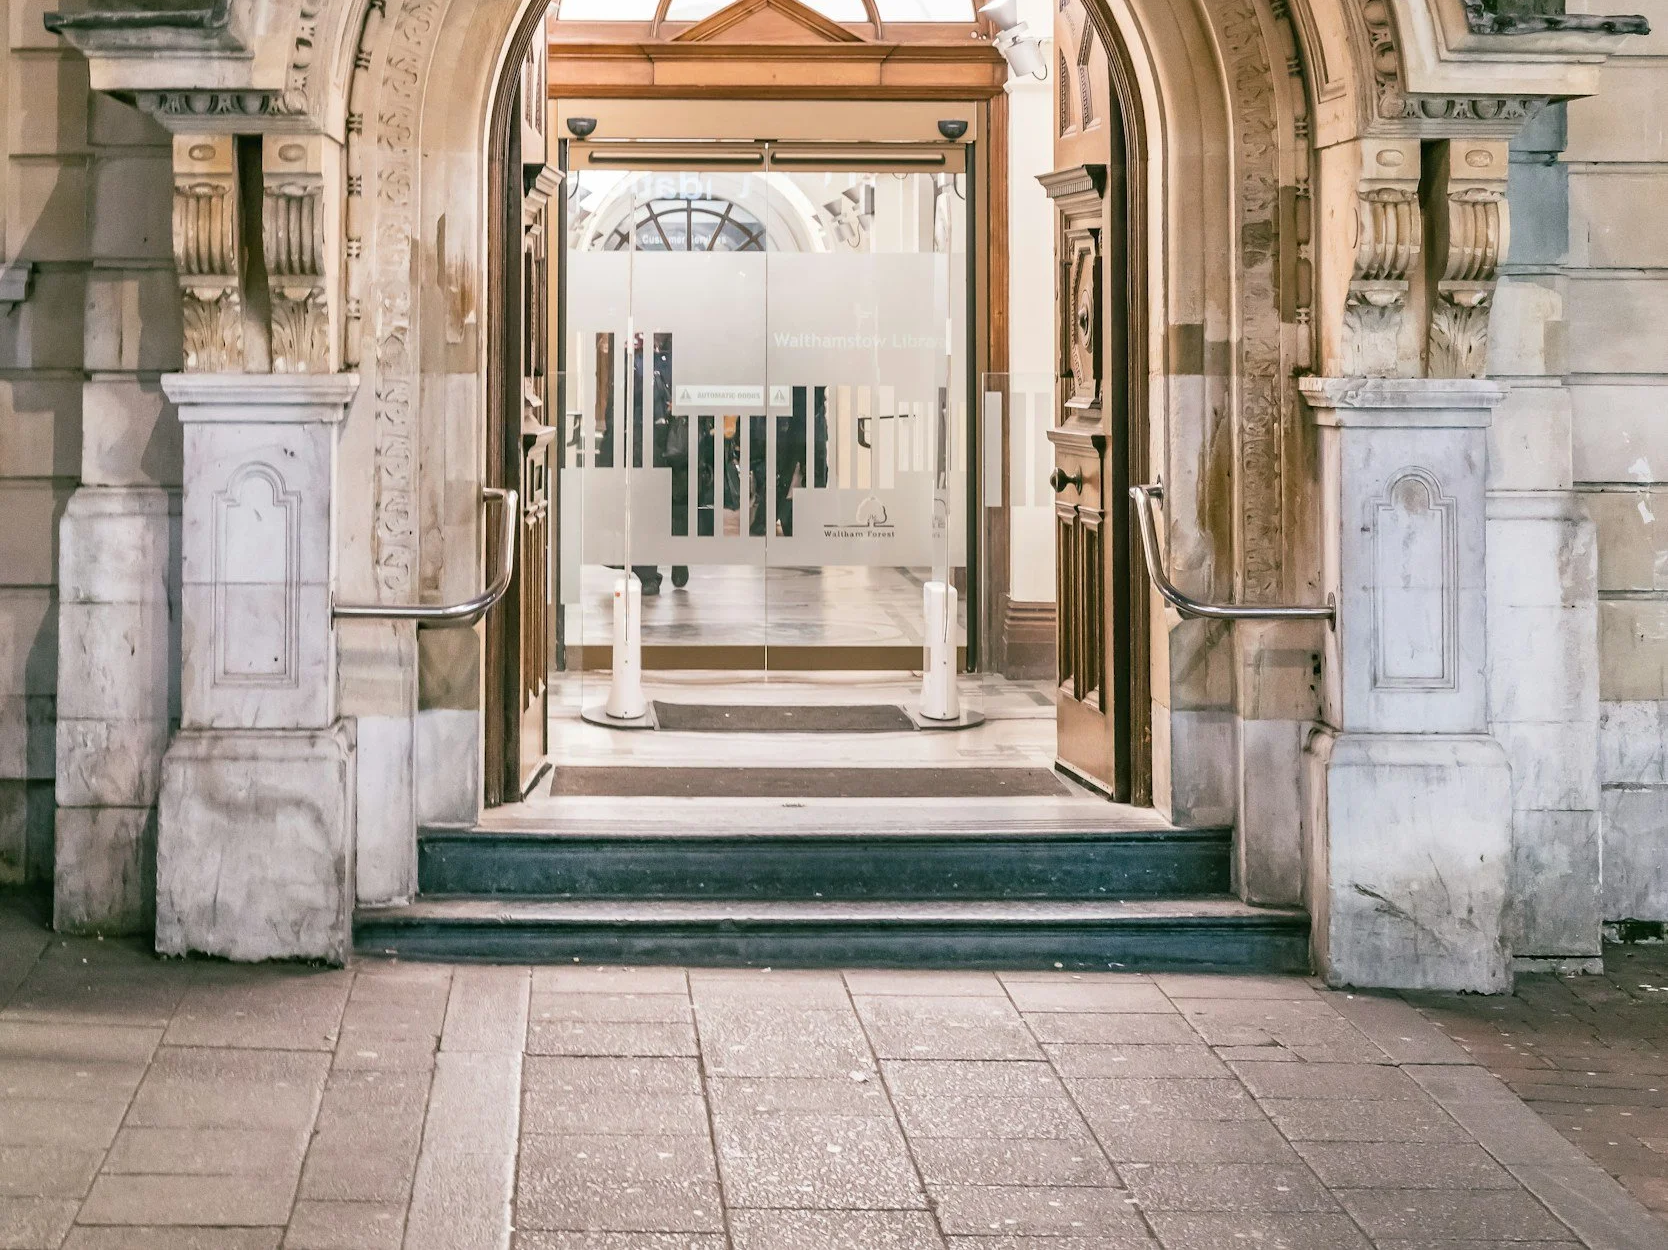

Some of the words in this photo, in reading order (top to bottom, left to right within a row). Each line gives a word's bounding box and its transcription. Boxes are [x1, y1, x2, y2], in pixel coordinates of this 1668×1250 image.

[773, 331, 887, 349] Walthamstow
[697, 391, 736, 400] AUTOMATIC
[823, 530, 864, 538] Waltham
[867, 530, 895, 538] Forest
